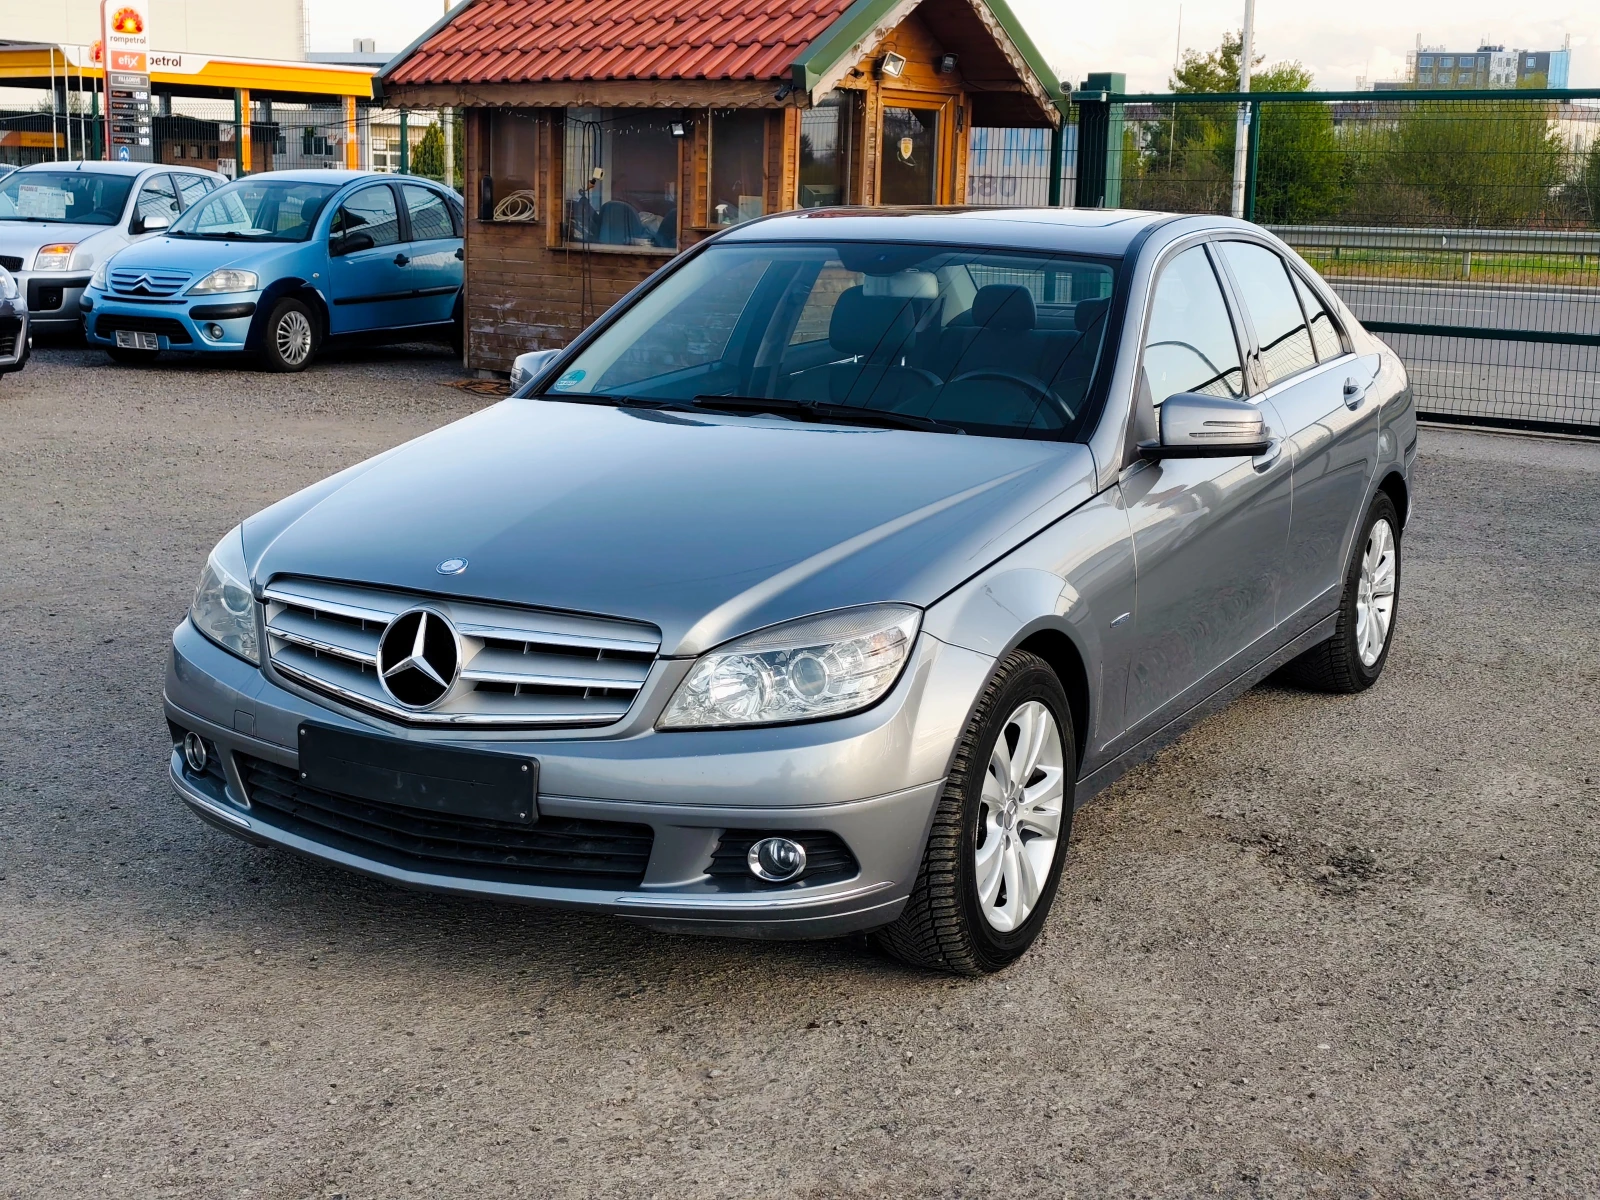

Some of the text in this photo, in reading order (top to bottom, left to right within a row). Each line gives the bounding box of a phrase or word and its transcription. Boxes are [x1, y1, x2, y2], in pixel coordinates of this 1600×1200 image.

[110, 36, 146, 45] rompetrol
[118, 54, 139, 68] efix
[150, 55, 182, 67] petrol
